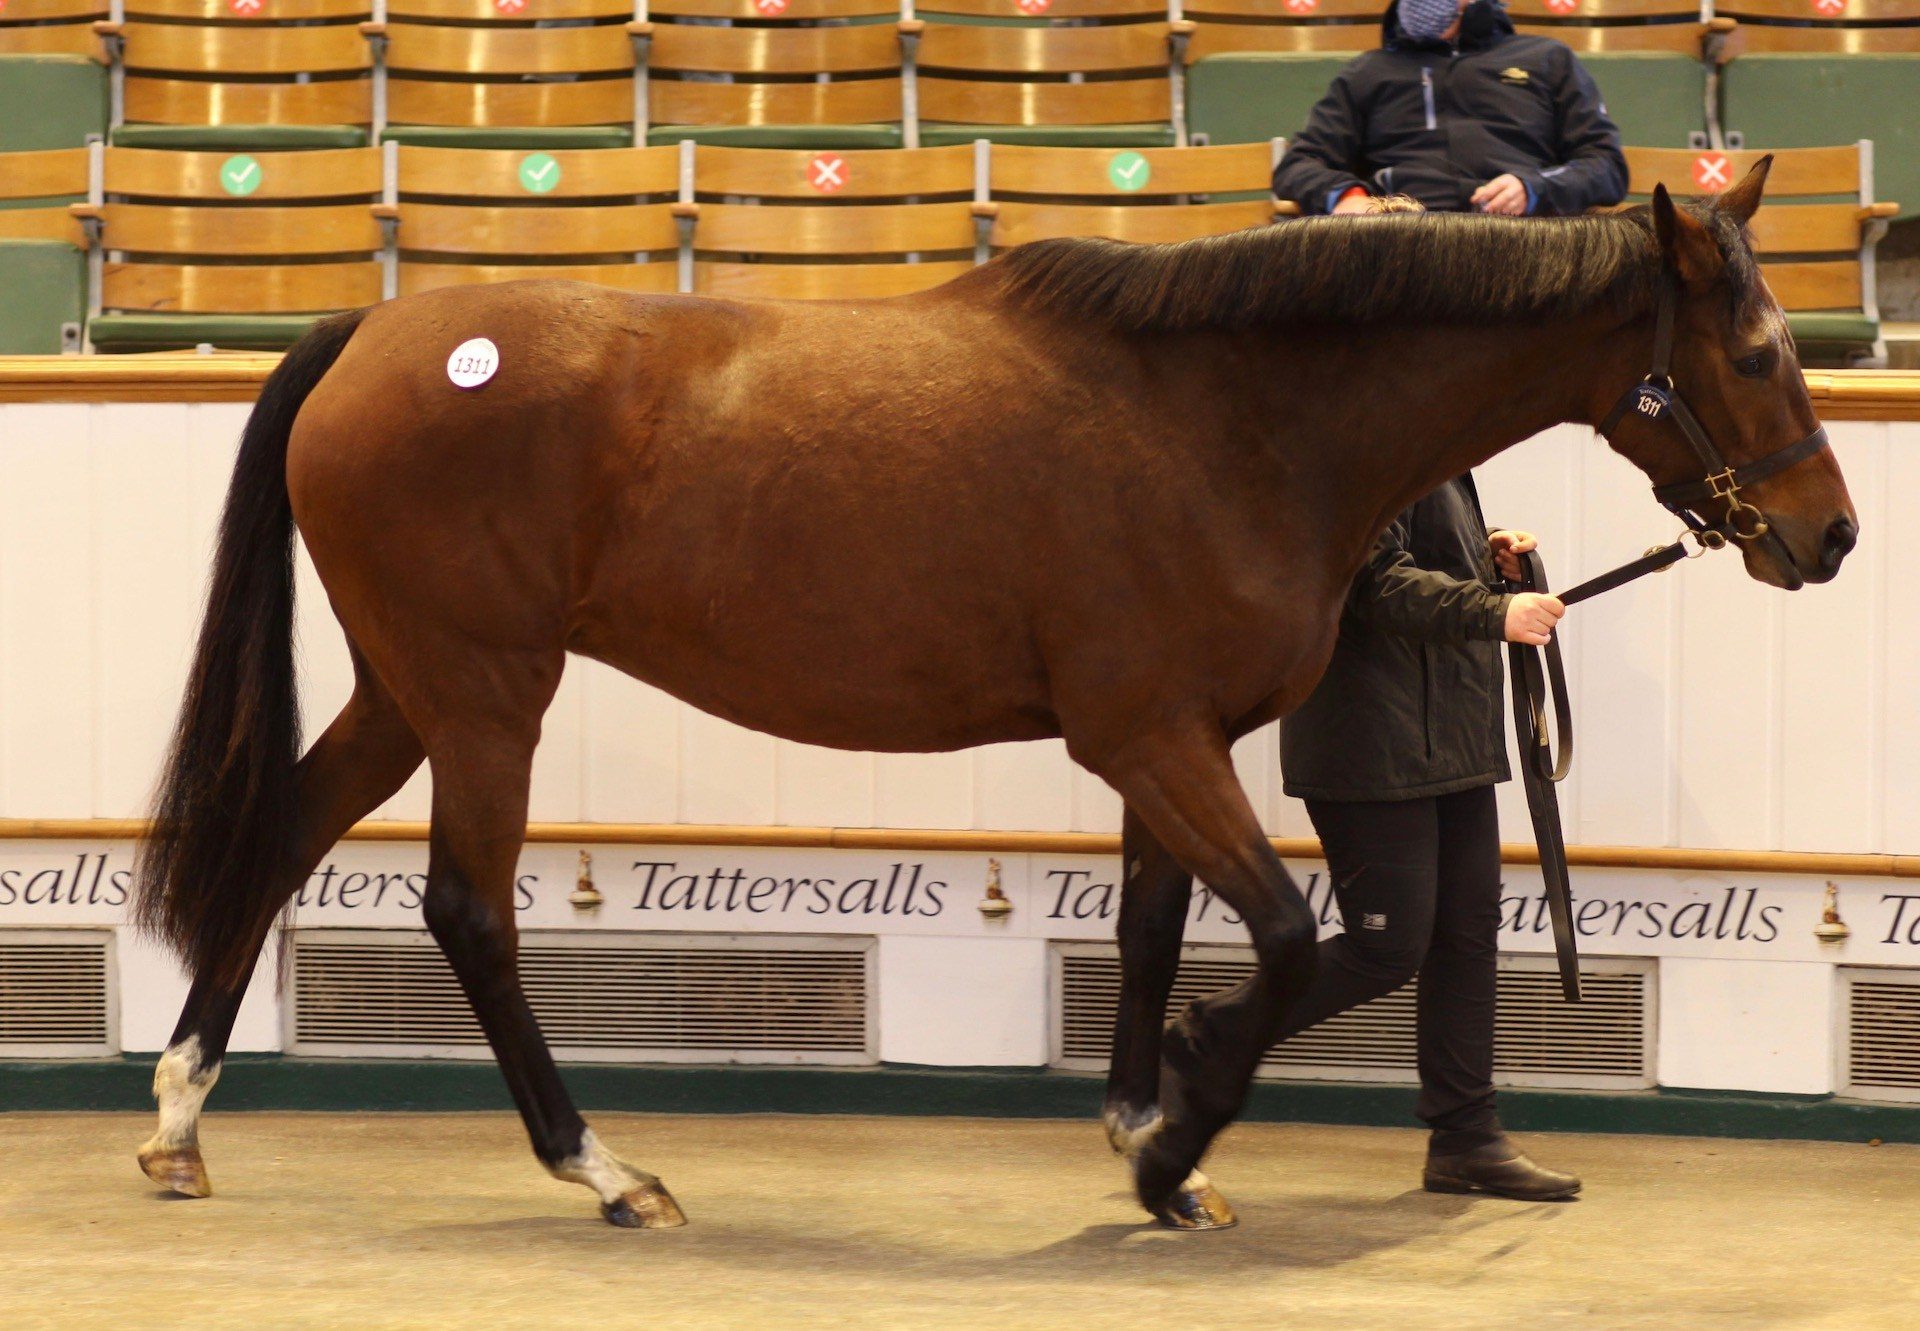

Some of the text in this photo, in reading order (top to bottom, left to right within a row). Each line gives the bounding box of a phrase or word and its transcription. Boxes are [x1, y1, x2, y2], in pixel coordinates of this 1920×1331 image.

[454, 357, 490, 374] 1311
[1637, 396, 1661, 417] 1311
[631, 861, 947, 917] Tattersalls
[1498, 884, 1783, 942] atersalls
